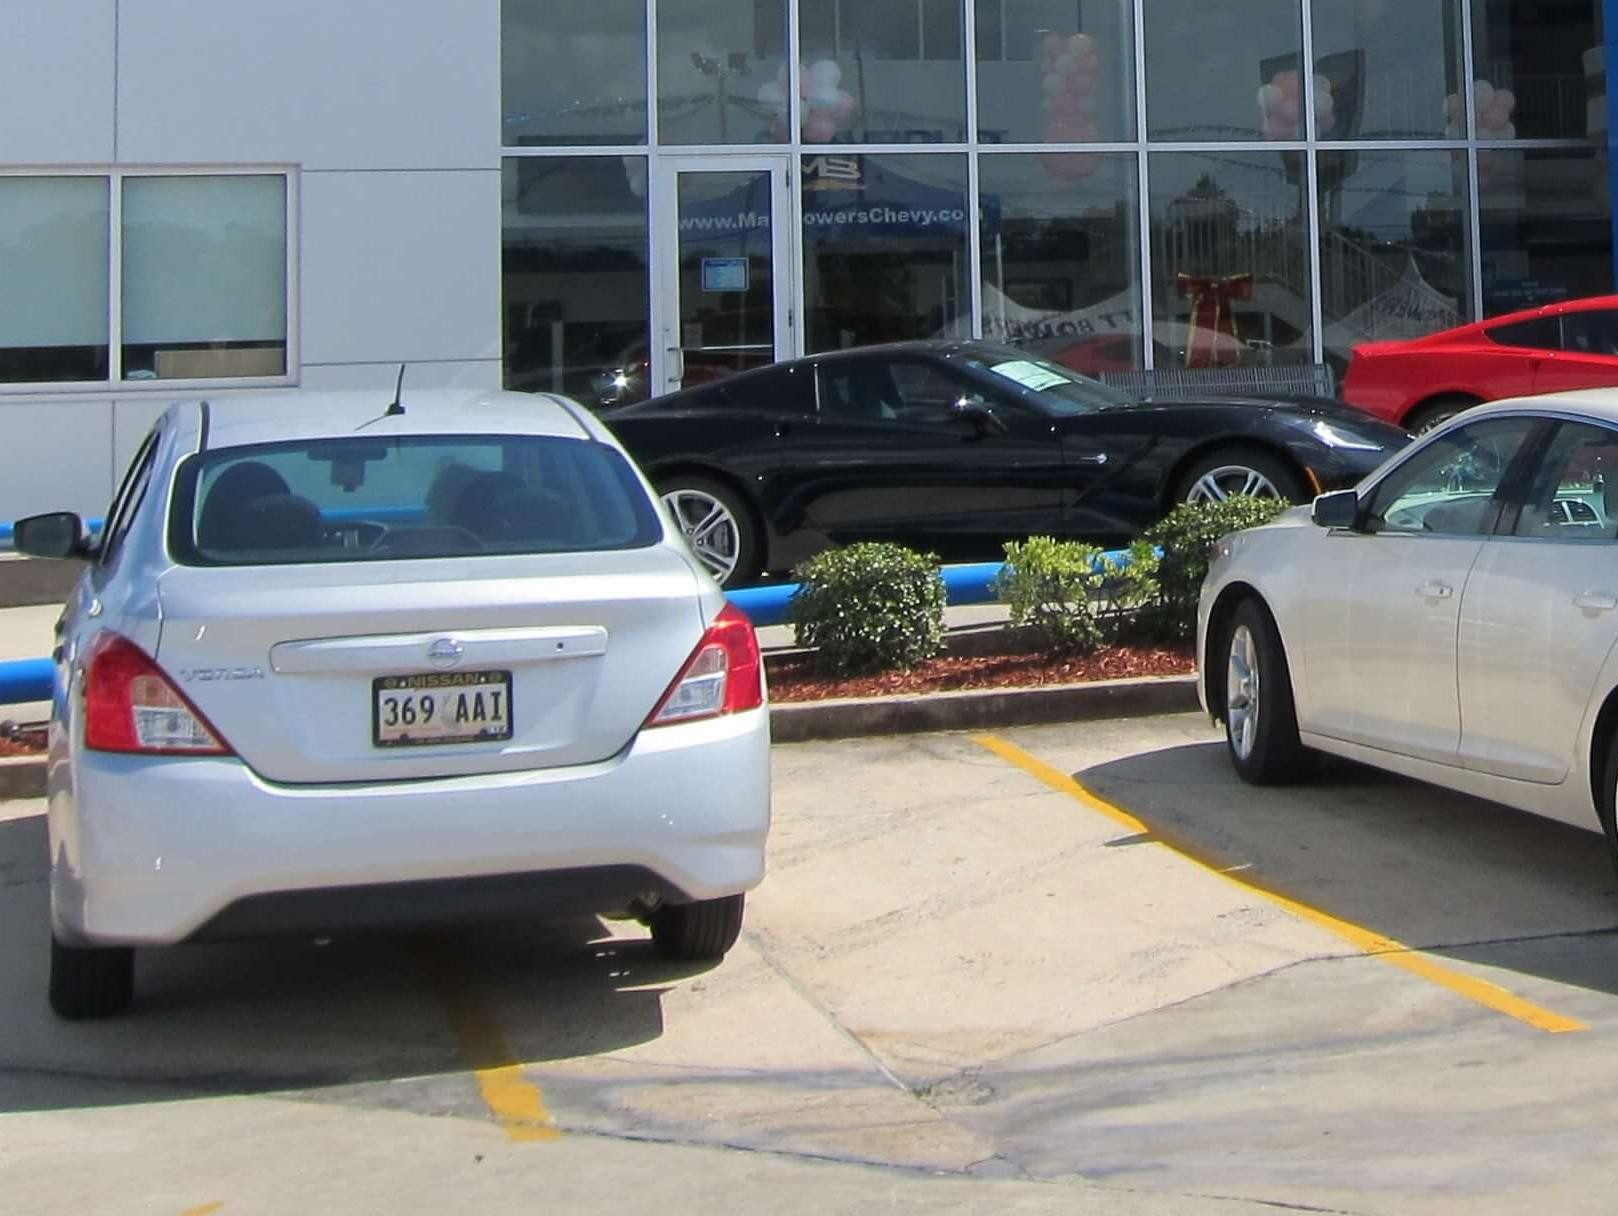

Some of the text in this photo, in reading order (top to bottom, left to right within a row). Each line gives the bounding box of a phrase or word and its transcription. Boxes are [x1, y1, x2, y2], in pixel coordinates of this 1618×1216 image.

[679, 206, 984, 230] www.MaowersChevy.co
[407, 674, 479, 688] NISSAN
[383, 691, 503, 727] 369 AAI
